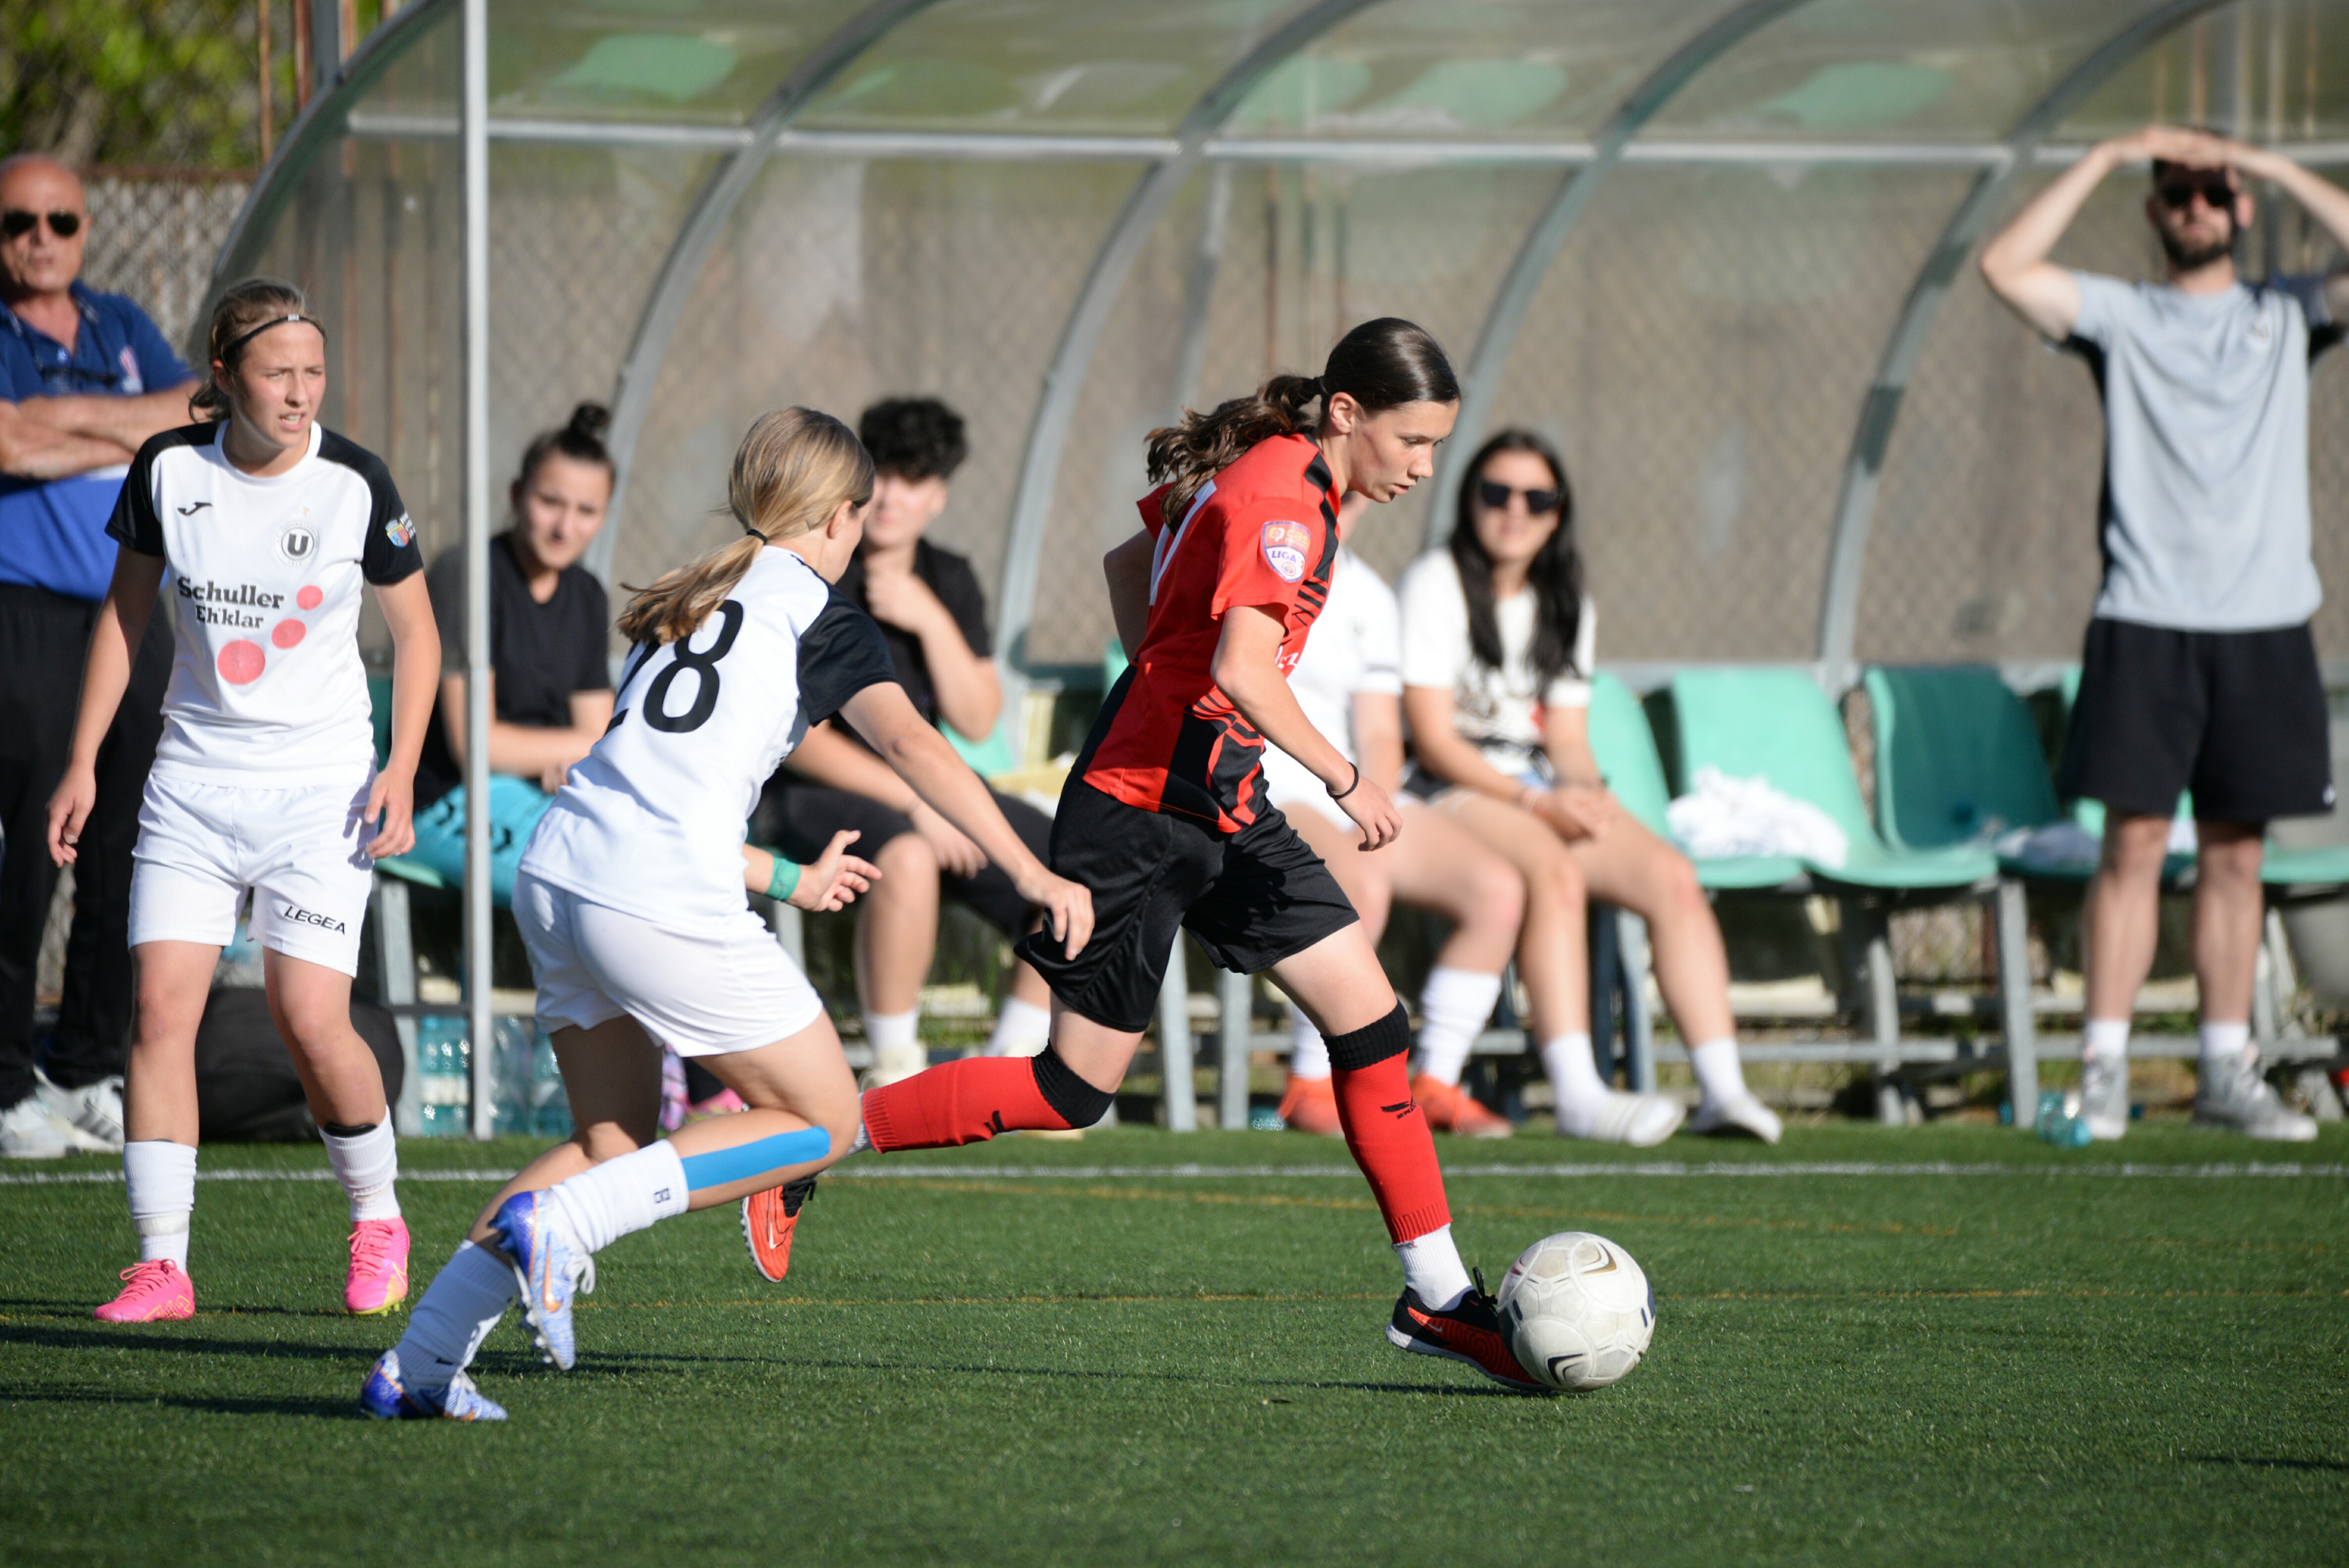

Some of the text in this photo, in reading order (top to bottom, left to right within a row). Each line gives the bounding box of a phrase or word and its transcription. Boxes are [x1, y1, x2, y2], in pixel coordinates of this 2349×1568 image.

[287, 533, 309, 557] U
[1271, 550, 1296, 564] LIGA
[177, 576, 284, 609] Schuller
[283, 905, 345, 935] LEGEA
